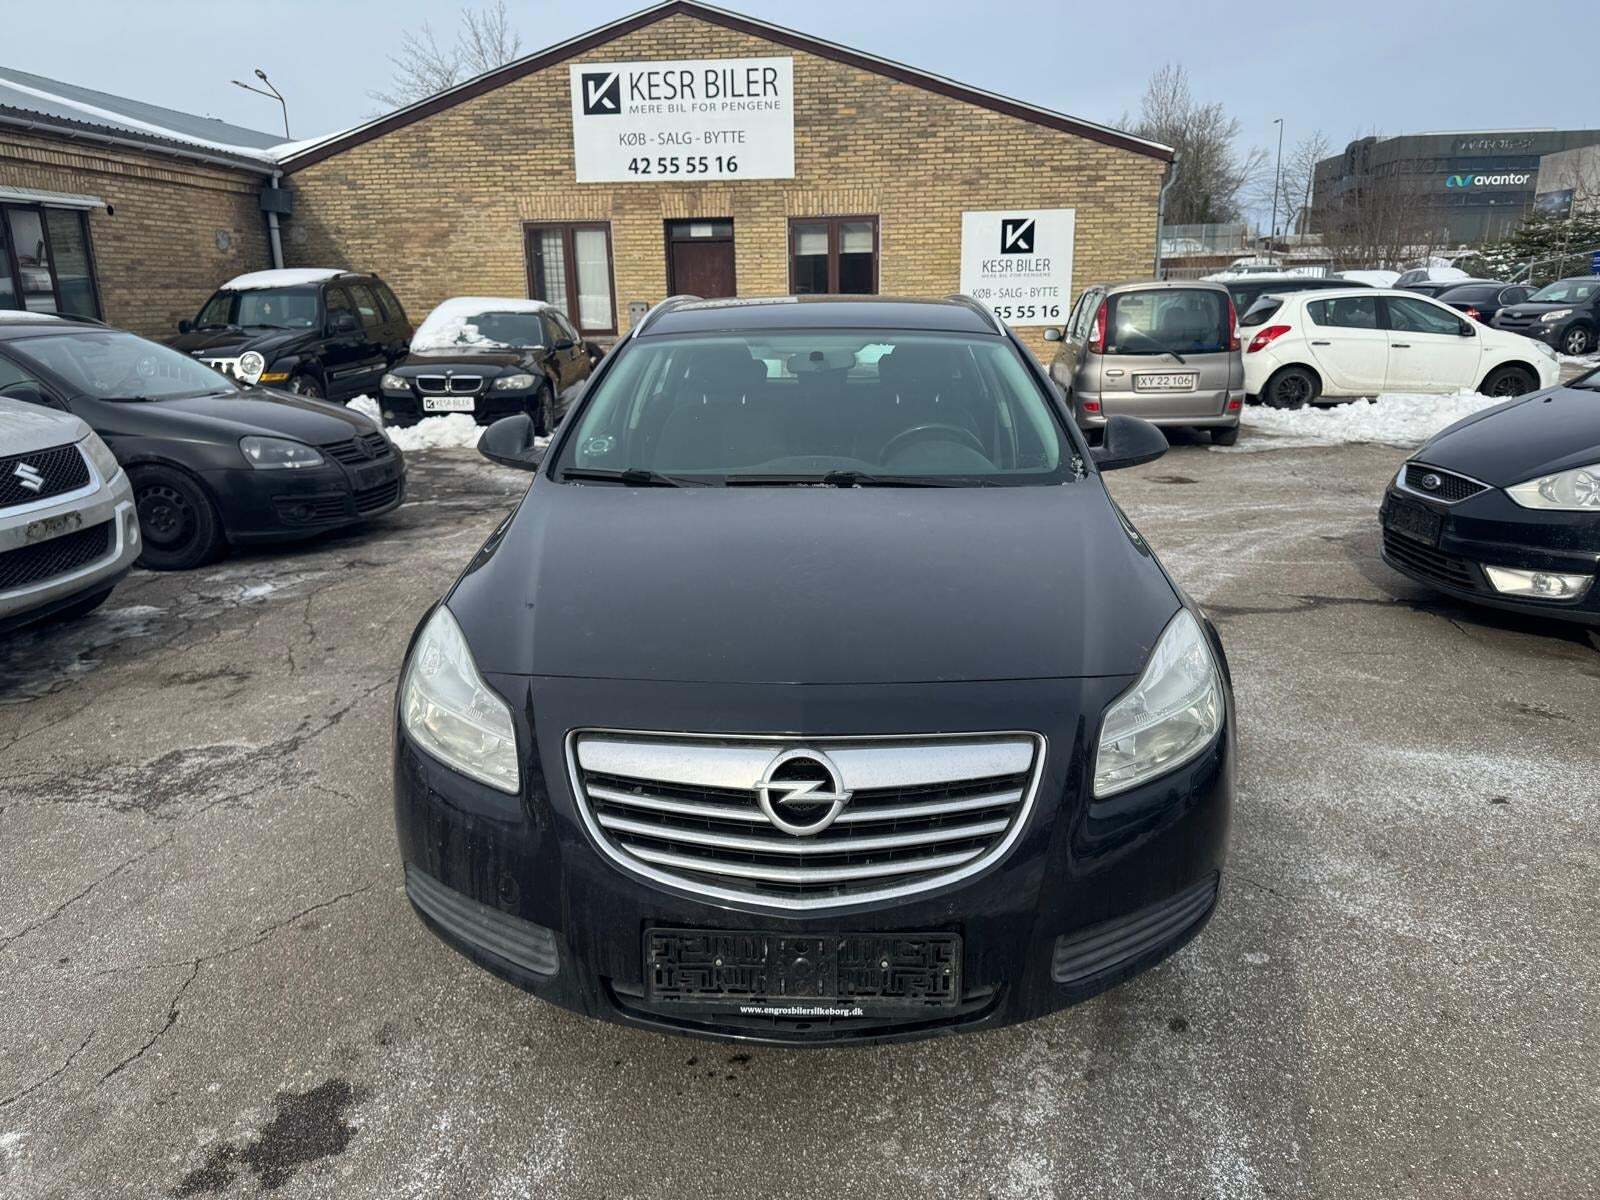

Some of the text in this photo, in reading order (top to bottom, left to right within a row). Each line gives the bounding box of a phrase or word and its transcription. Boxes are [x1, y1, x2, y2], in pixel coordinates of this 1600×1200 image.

[629, 67, 779, 101] KESR BILER
[629, 100, 781, 114] MERE BIL FOR PENGENE
[619, 132, 646, 146] KØB
[658, 132, 692, 145] SALG
[704, 130, 745, 144] BYTTE
[628, 156, 738, 174] 42 55 55 16
[1474, 173, 1530, 185] avantor
[982, 258, 1050, 273] KESR BILER
[972, 288, 991, 299] KØB
[999, 287, 1022, 298] SALG
[1030, 286, 1059, 297] BYTTE
[1017, 306, 1036, 318] 55
[1042, 305, 1060, 317] 16
[1140, 376, 1190, 385] XY 22 106
[740, 1006, 863, 1016] www.engrosbilersilkeborg.dk
